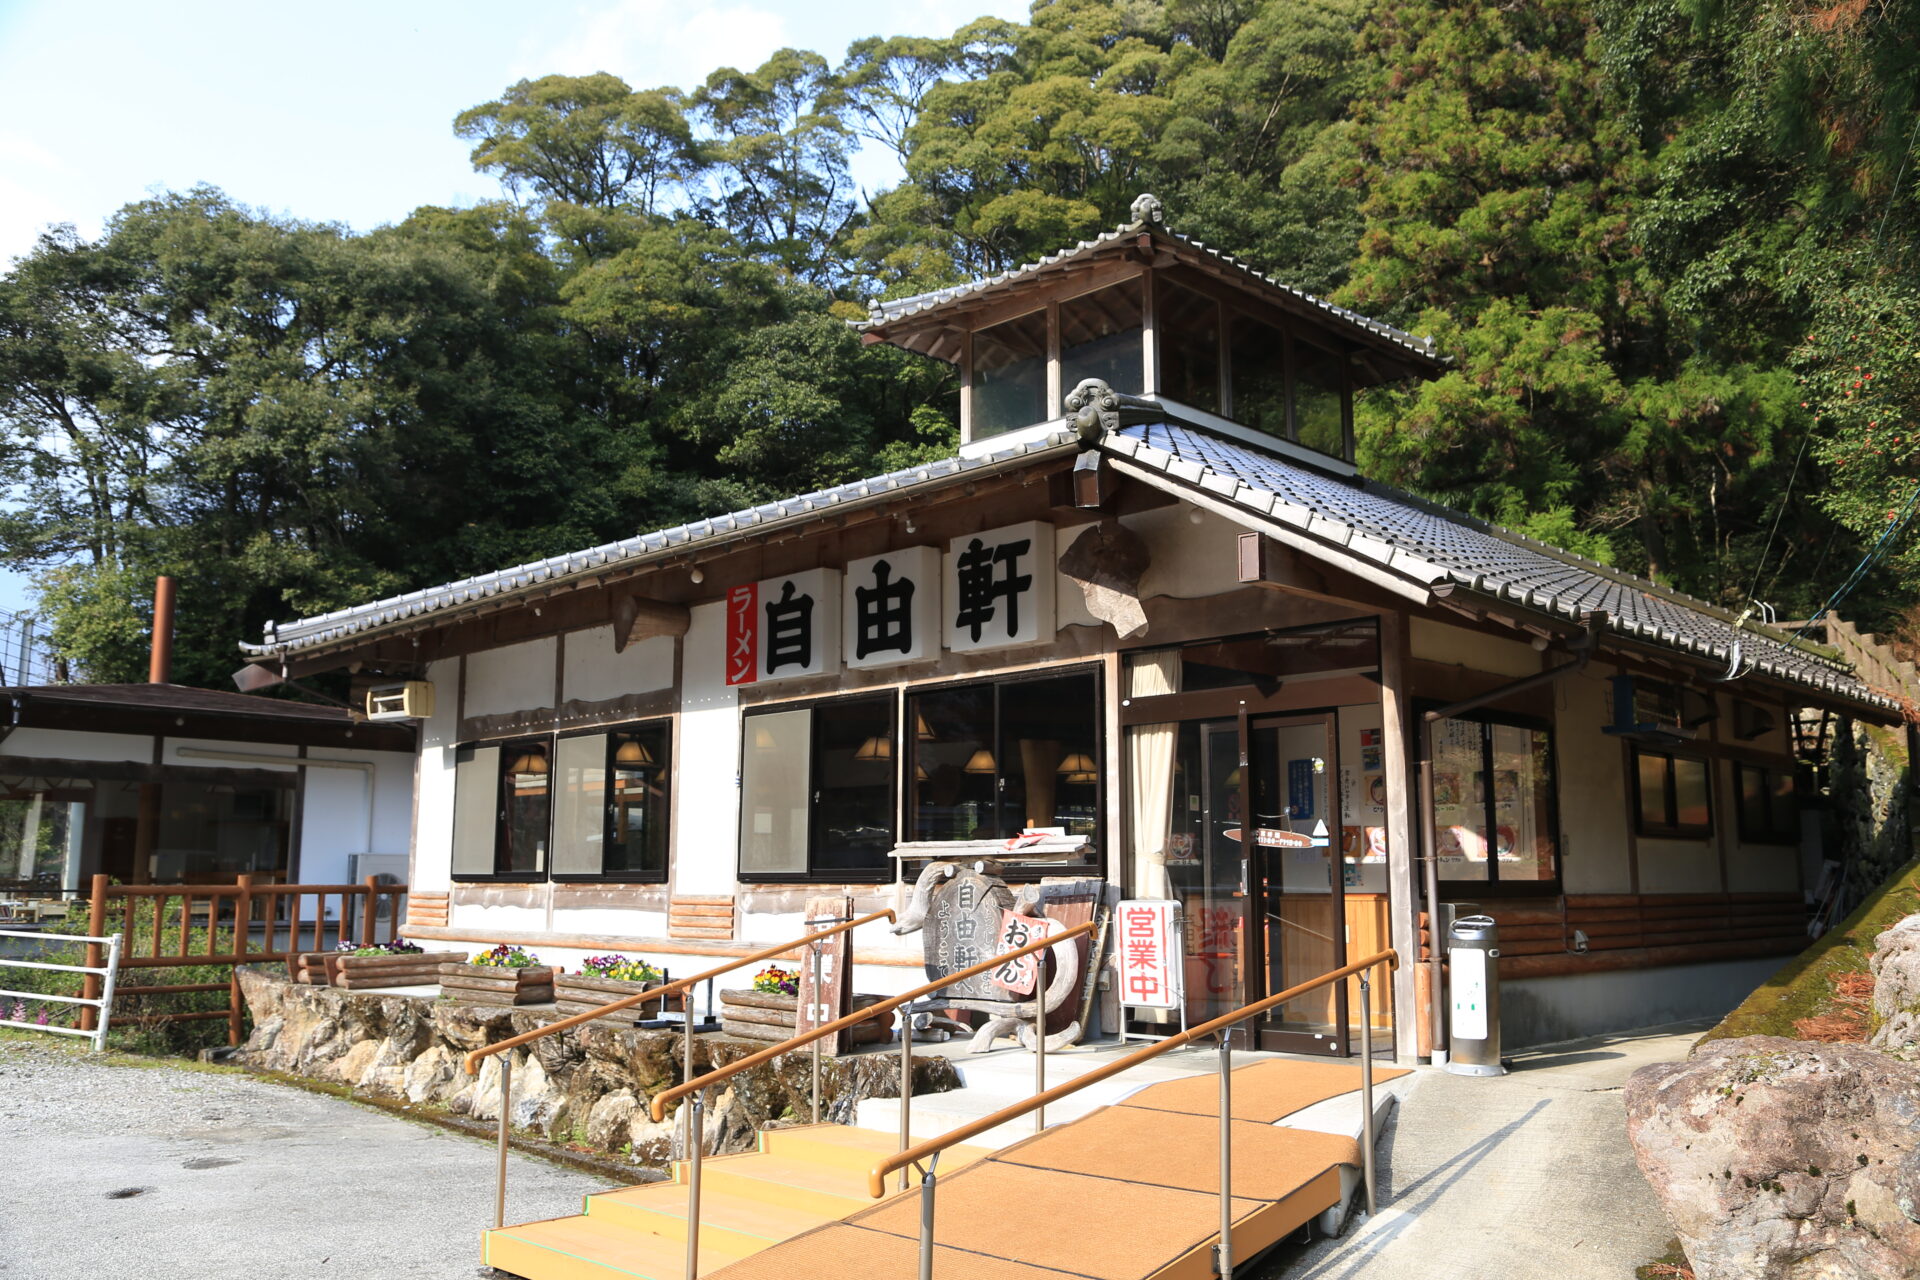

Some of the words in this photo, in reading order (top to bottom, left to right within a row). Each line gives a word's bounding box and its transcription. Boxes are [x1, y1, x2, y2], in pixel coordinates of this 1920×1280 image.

[730, 586, 752, 684] ラーメン
[765, 538, 1032, 675] 自由軒
[1126, 906, 1159, 1002] 営業中
